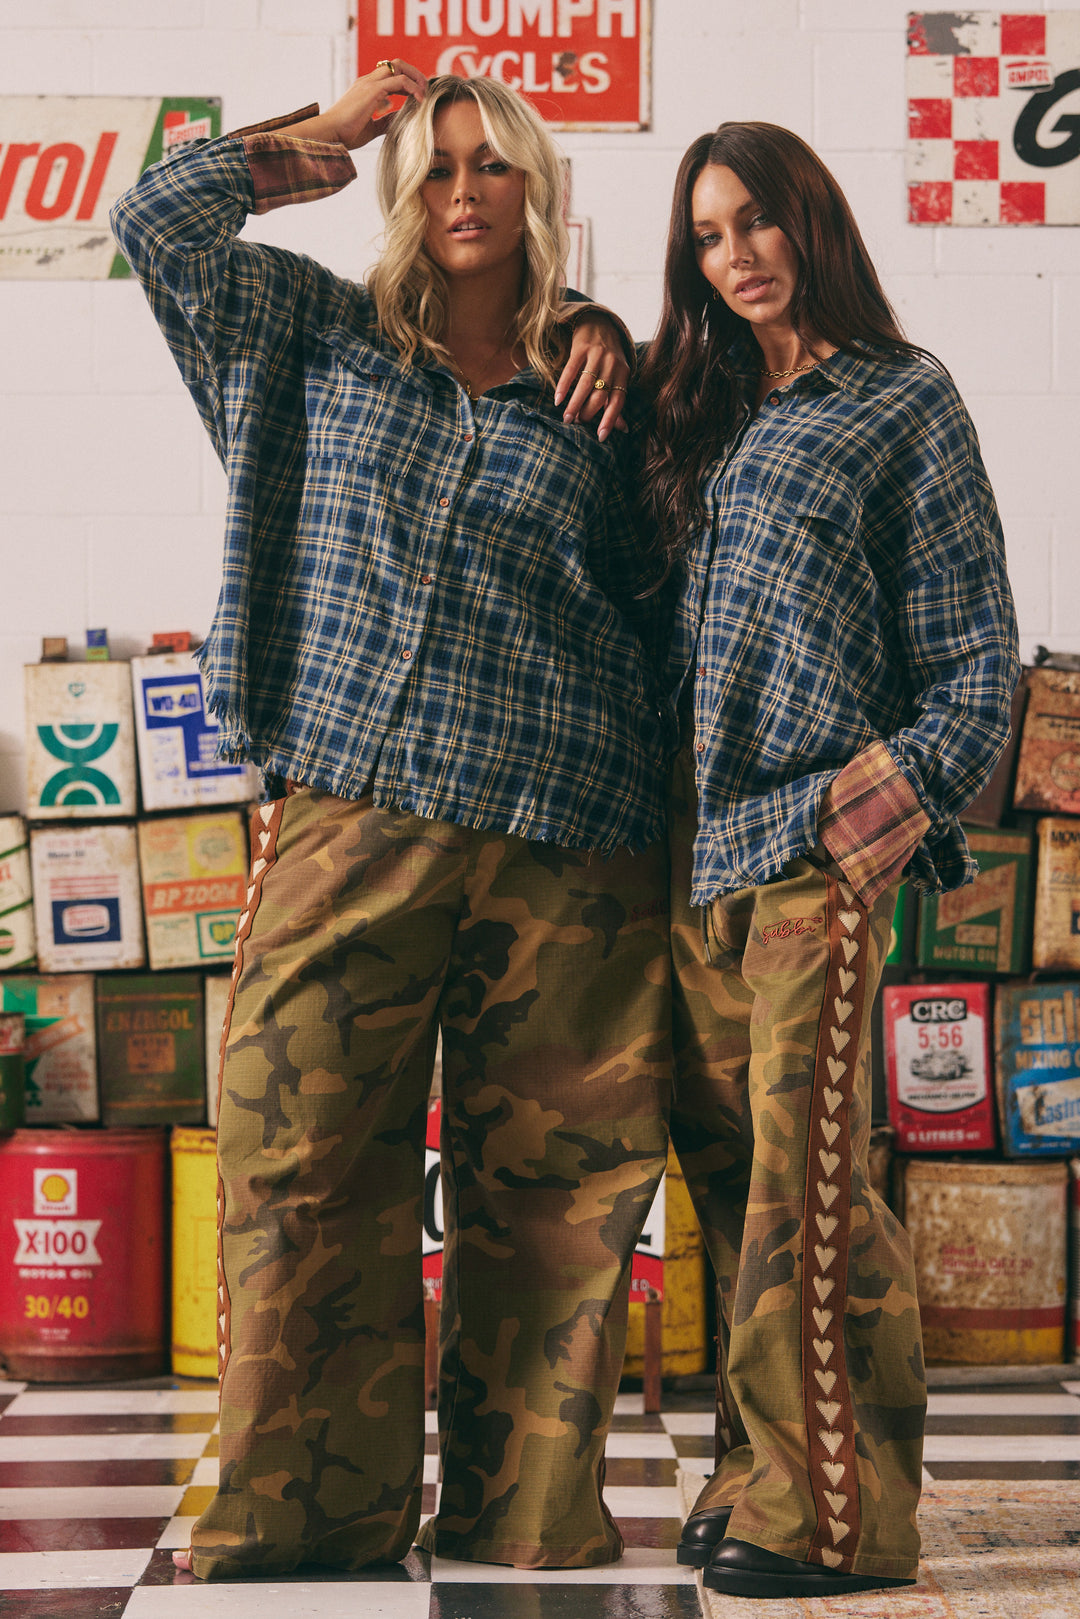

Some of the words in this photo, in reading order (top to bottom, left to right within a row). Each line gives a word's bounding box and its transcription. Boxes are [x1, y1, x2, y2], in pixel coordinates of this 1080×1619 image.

[372, 0, 636, 38] TRIUMPH
[437, 45, 611, 94] CYCLES
[0, 132, 119, 222] rol
[152, 886, 181, 909] BP
[182, 881, 241, 905] ZOOM
[912, 1000, 965, 1021] CRC
[1015, 1049, 1071, 1070] MIXING
[19, 1268, 67, 1280] MOTOR
[70, 1268, 93, 1280] OIL
[24, 1295, 89, 1320] 30/40
